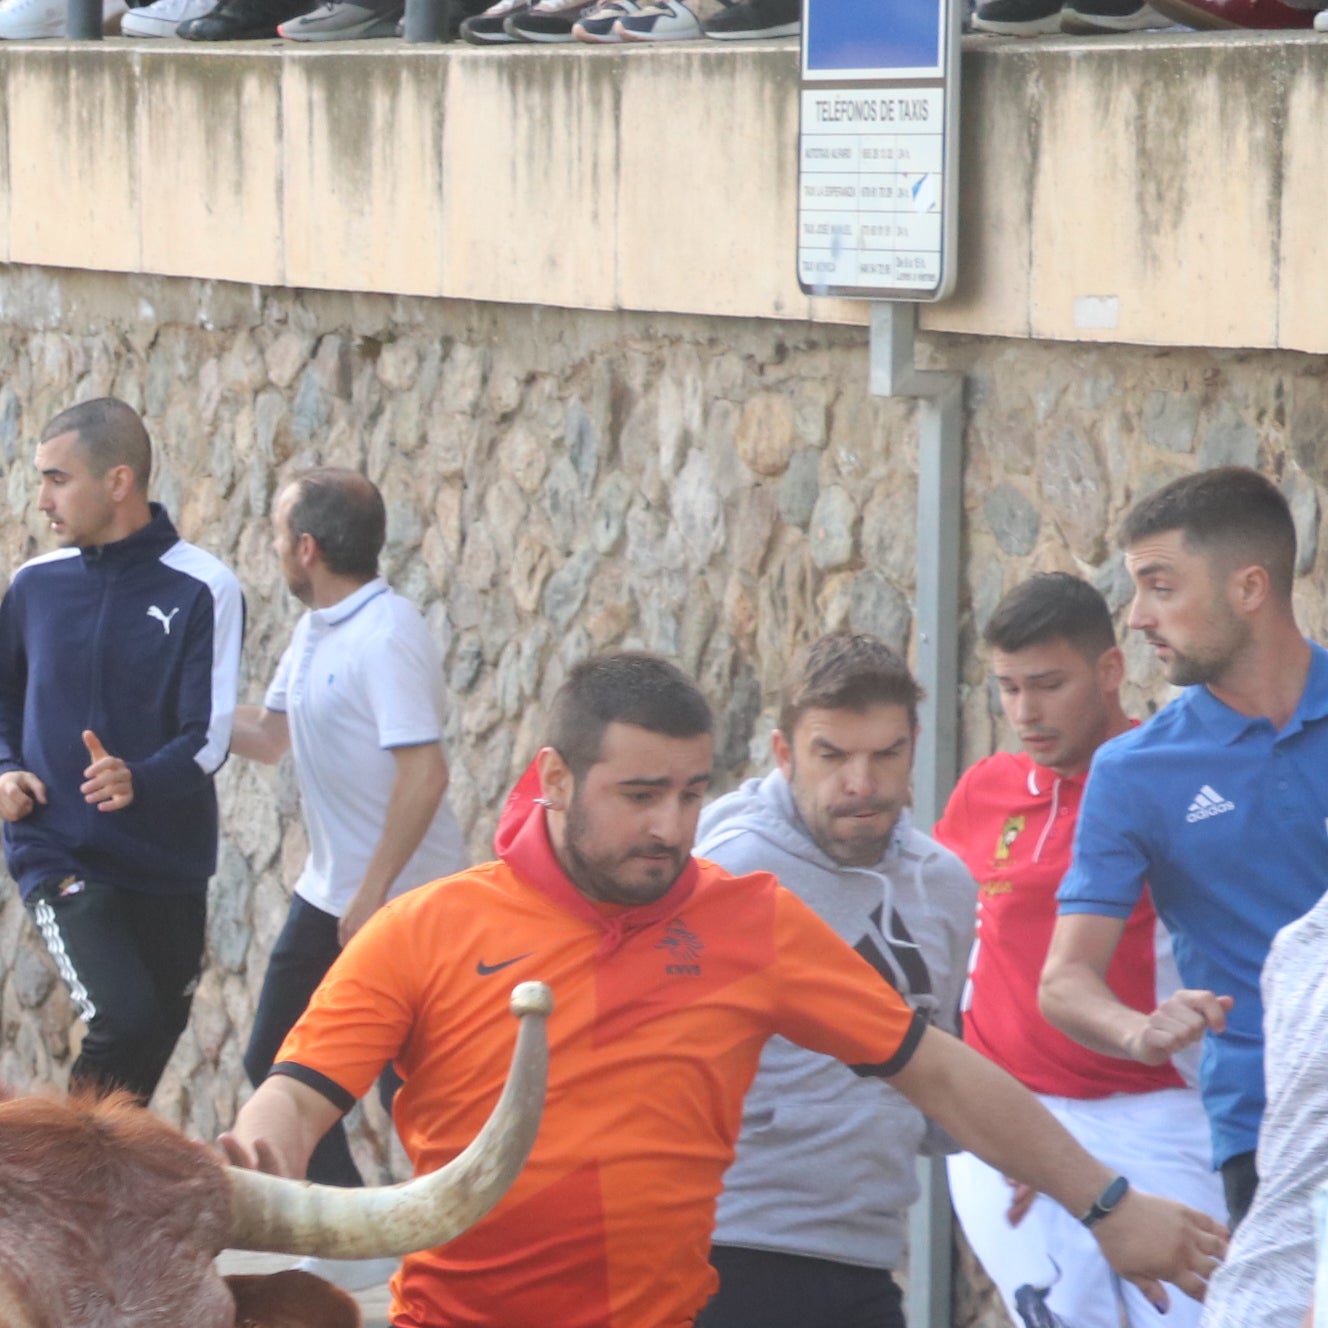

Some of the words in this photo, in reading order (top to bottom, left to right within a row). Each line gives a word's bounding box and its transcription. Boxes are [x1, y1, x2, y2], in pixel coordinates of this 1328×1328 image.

[880, 99, 895, 121] DE
[897, 99, 929, 121] TAXIS
[1185, 800, 1236, 824] adidas
